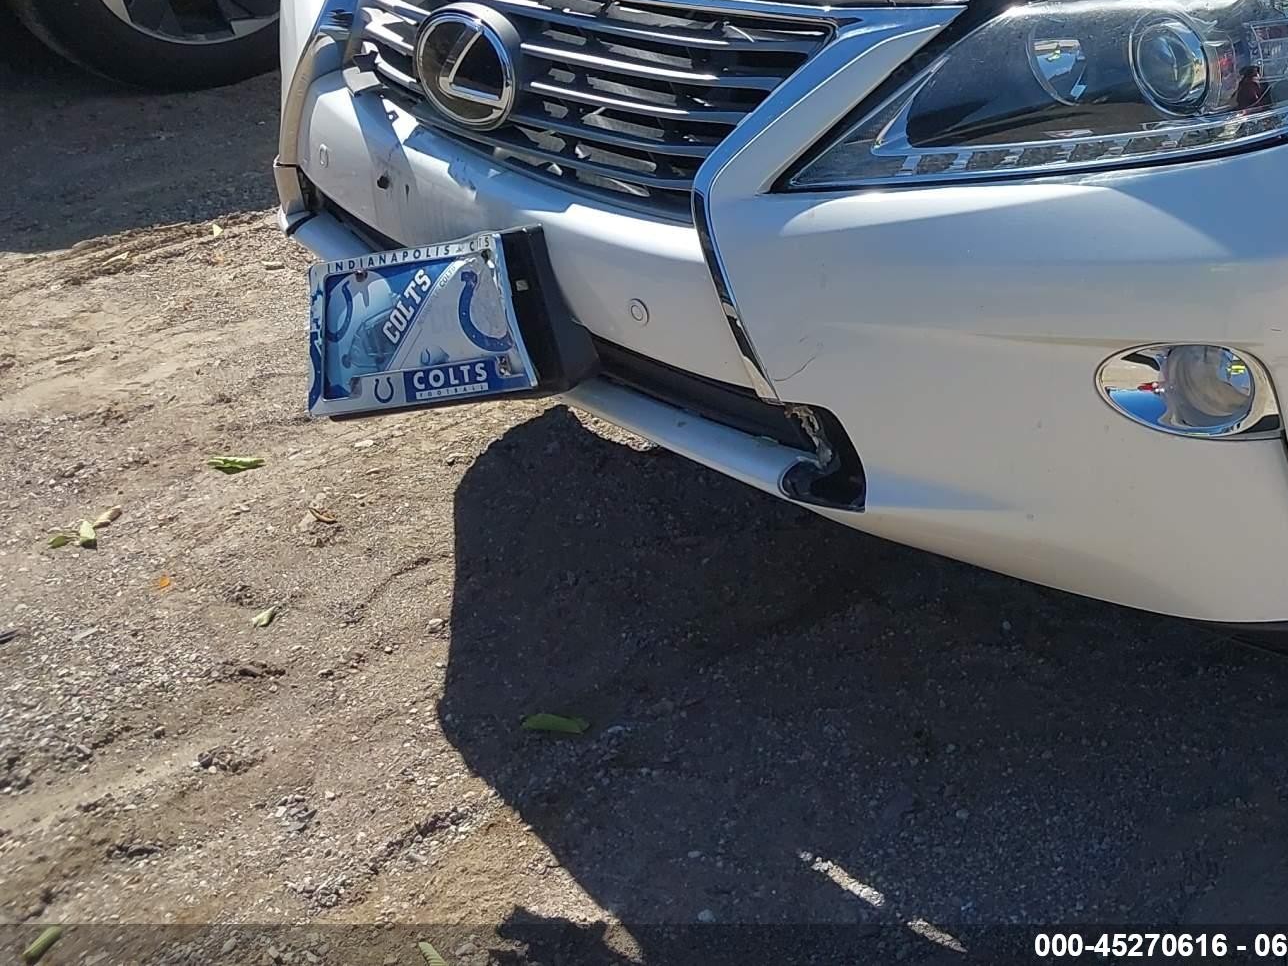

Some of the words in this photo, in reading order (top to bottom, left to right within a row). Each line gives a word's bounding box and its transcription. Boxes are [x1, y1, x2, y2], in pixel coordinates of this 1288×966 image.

[327, 244, 450, 273] INDIANAPOLIS
[383, 269, 431, 344] COLTS
[413, 362, 487, 389] COLTS
